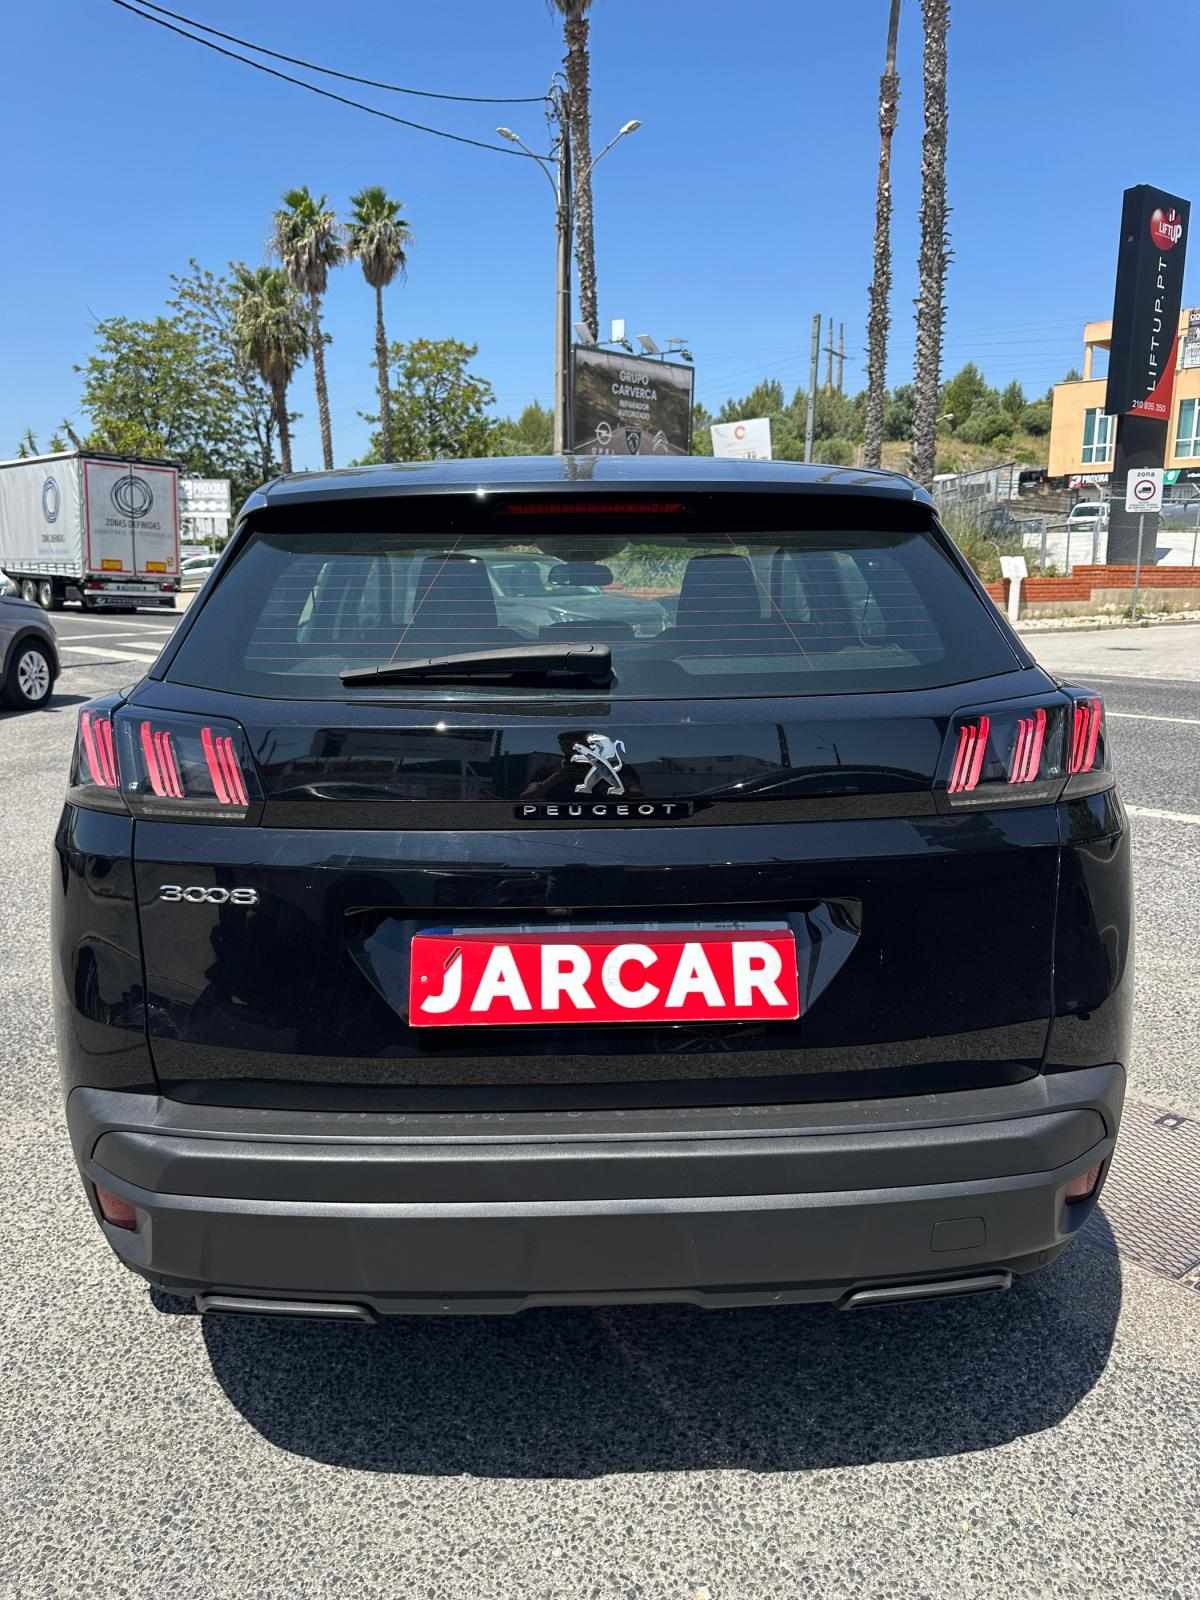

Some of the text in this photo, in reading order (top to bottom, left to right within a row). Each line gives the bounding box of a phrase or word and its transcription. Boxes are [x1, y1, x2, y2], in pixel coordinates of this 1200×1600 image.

[1159, 221, 1183, 244] LIFTUP
[1147, 256, 1168, 392] LIFTUP.PT
[619, 370, 649, 385] GRUPO
[611, 383, 657, 401] CARVERCA
[523, 804, 677, 816] PEUGEOT
[159, 885, 258, 905] 3008
[420, 940, 789, 1014] JARCAR
